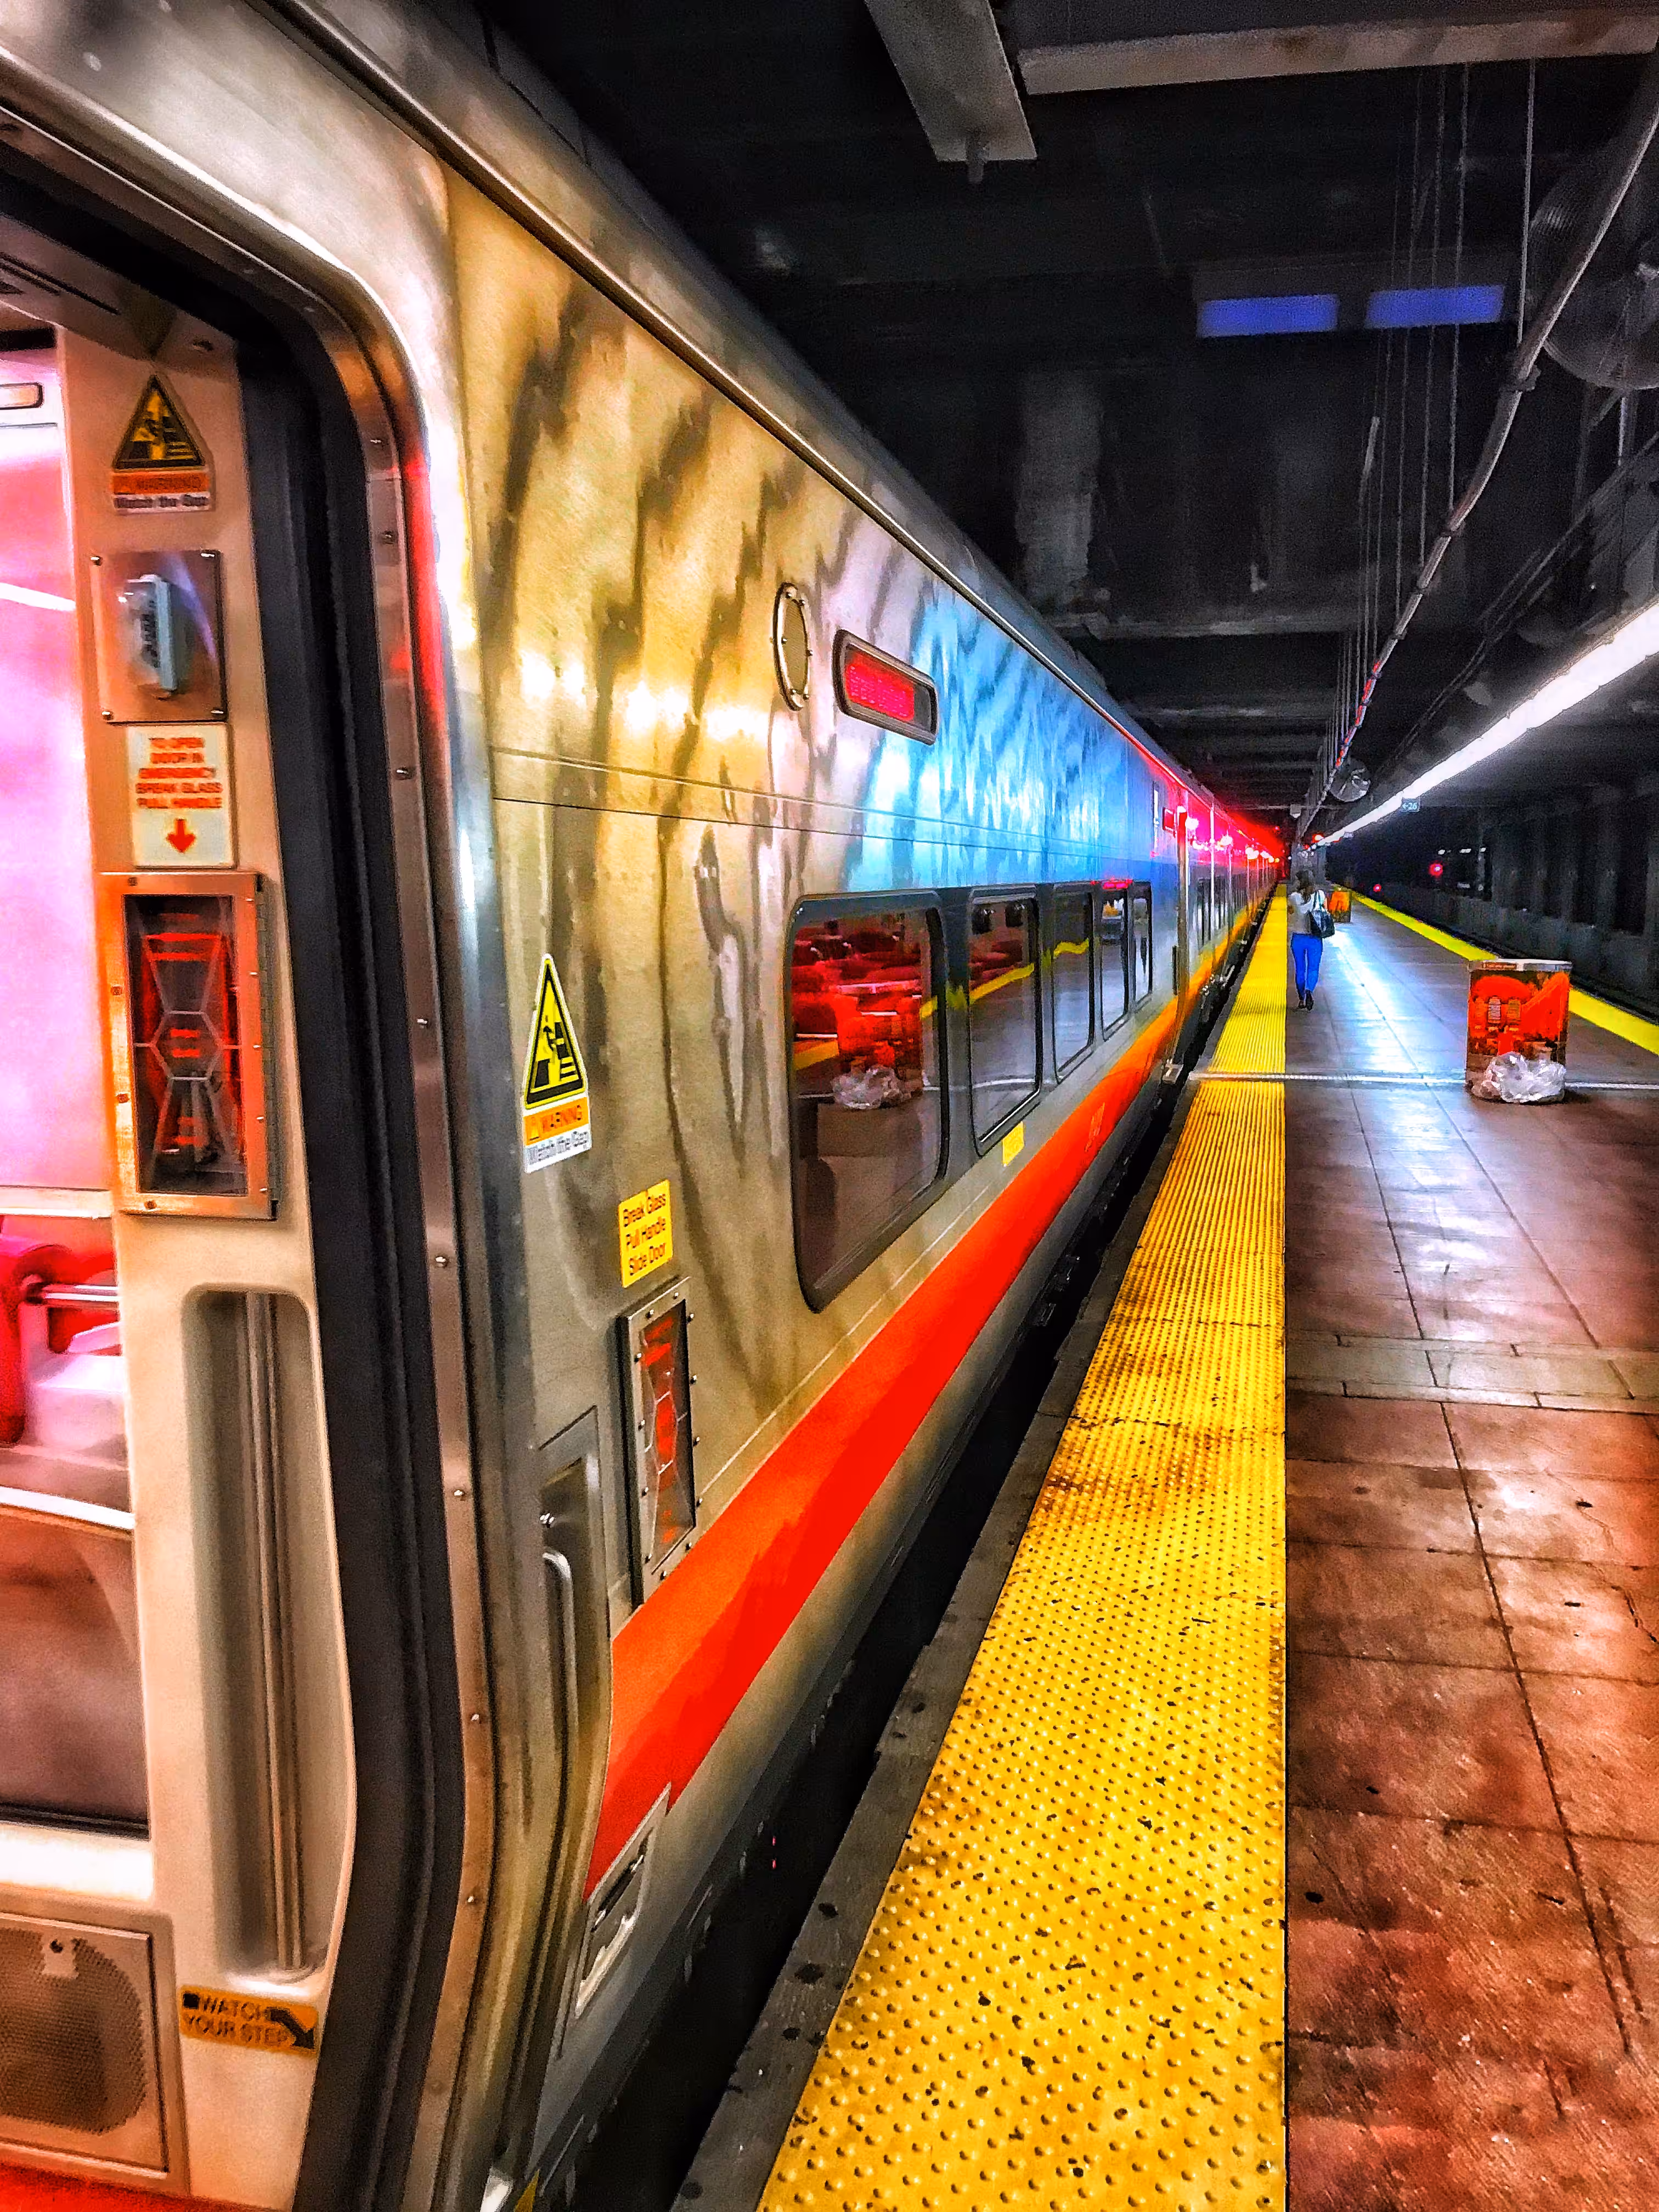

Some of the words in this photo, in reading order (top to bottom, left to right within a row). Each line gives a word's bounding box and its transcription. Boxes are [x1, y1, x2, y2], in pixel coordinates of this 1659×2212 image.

[646, 1193, 666, 1214] Glass
[201, 1995, 269, 2021] WATCH
[184, 2013, 236, 2037] YOUR
[240, 2022, 290, 2047] STEP
